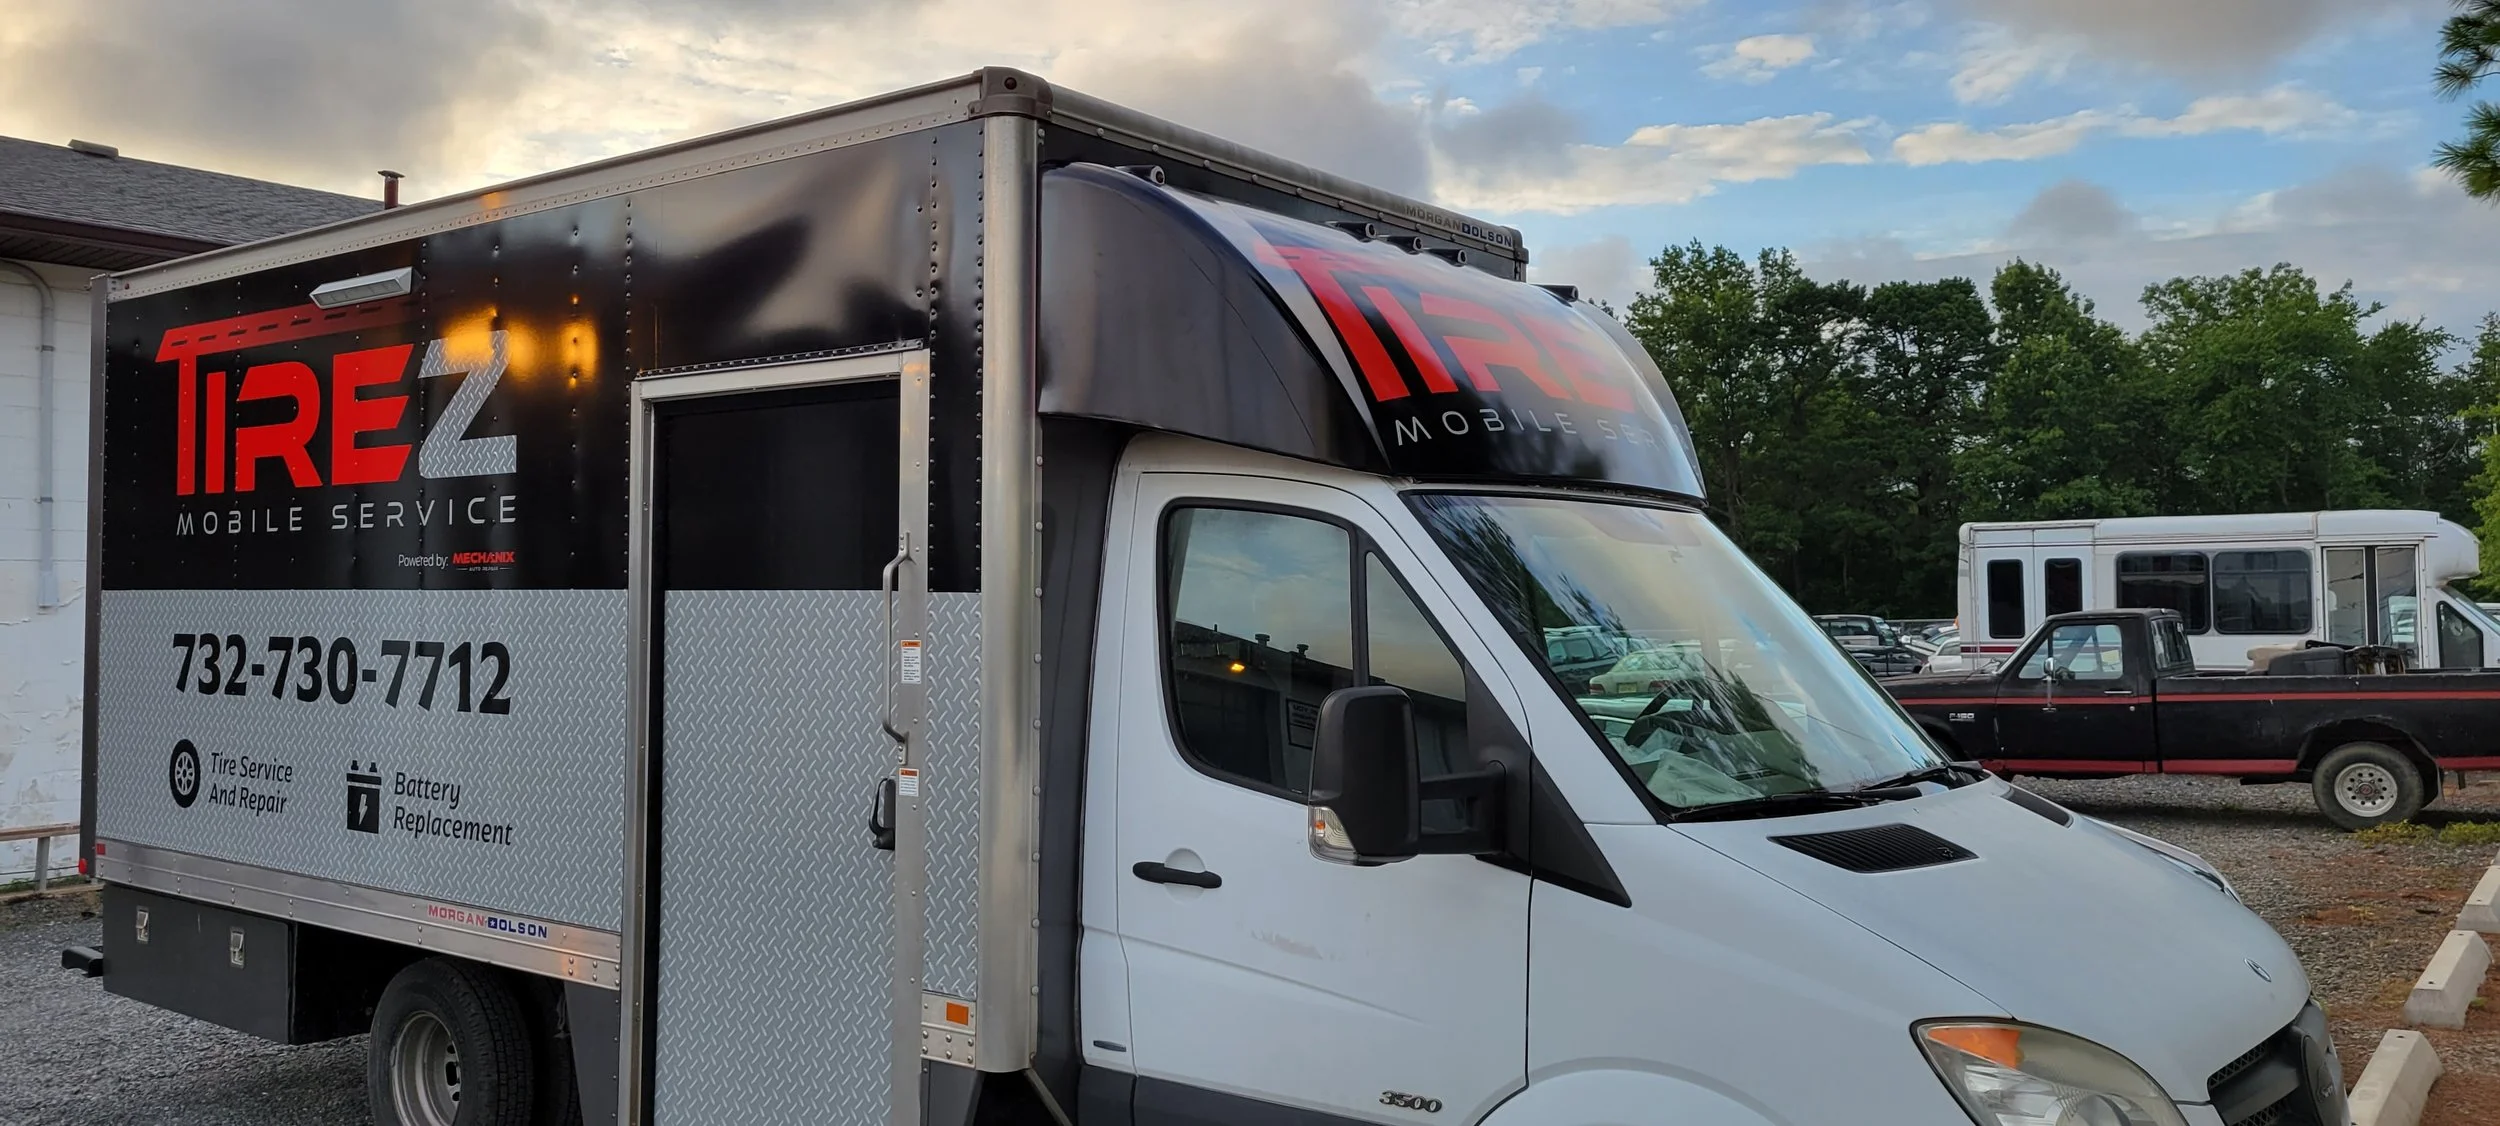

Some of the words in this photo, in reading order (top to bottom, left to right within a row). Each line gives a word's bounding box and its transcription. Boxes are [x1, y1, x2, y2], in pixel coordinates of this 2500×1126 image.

[1406, 205, 1460, 231] MORGAN
[1471, 226, 1513, 247] OLSON
[154, 297, 518, 496] TIREZ
[1396, 408, 1578, 446] MOBILE
[177, 507, 303, 537] MOBILE
[332, 495, 517, 531] SERVICE
[398, 553, 434, 568] Powered
[452, 551, 516, 565] MECHANIX
[172, 632, 512, 716] 732-730-7712
[211, 751, 237, 776] Tire
[240, 755, 293, 783] Service
[208, 782, 237, 807] And
[239, 786, 288, 817] Repair
[394, 772, 462, 809] Battery
[393, 806, 514, 847] Replacement
[428, 904, 486, 927] MORGAN
[499, 919, 548, 939] OLSON
[1378, 1089, 1443, 1114] 3500
